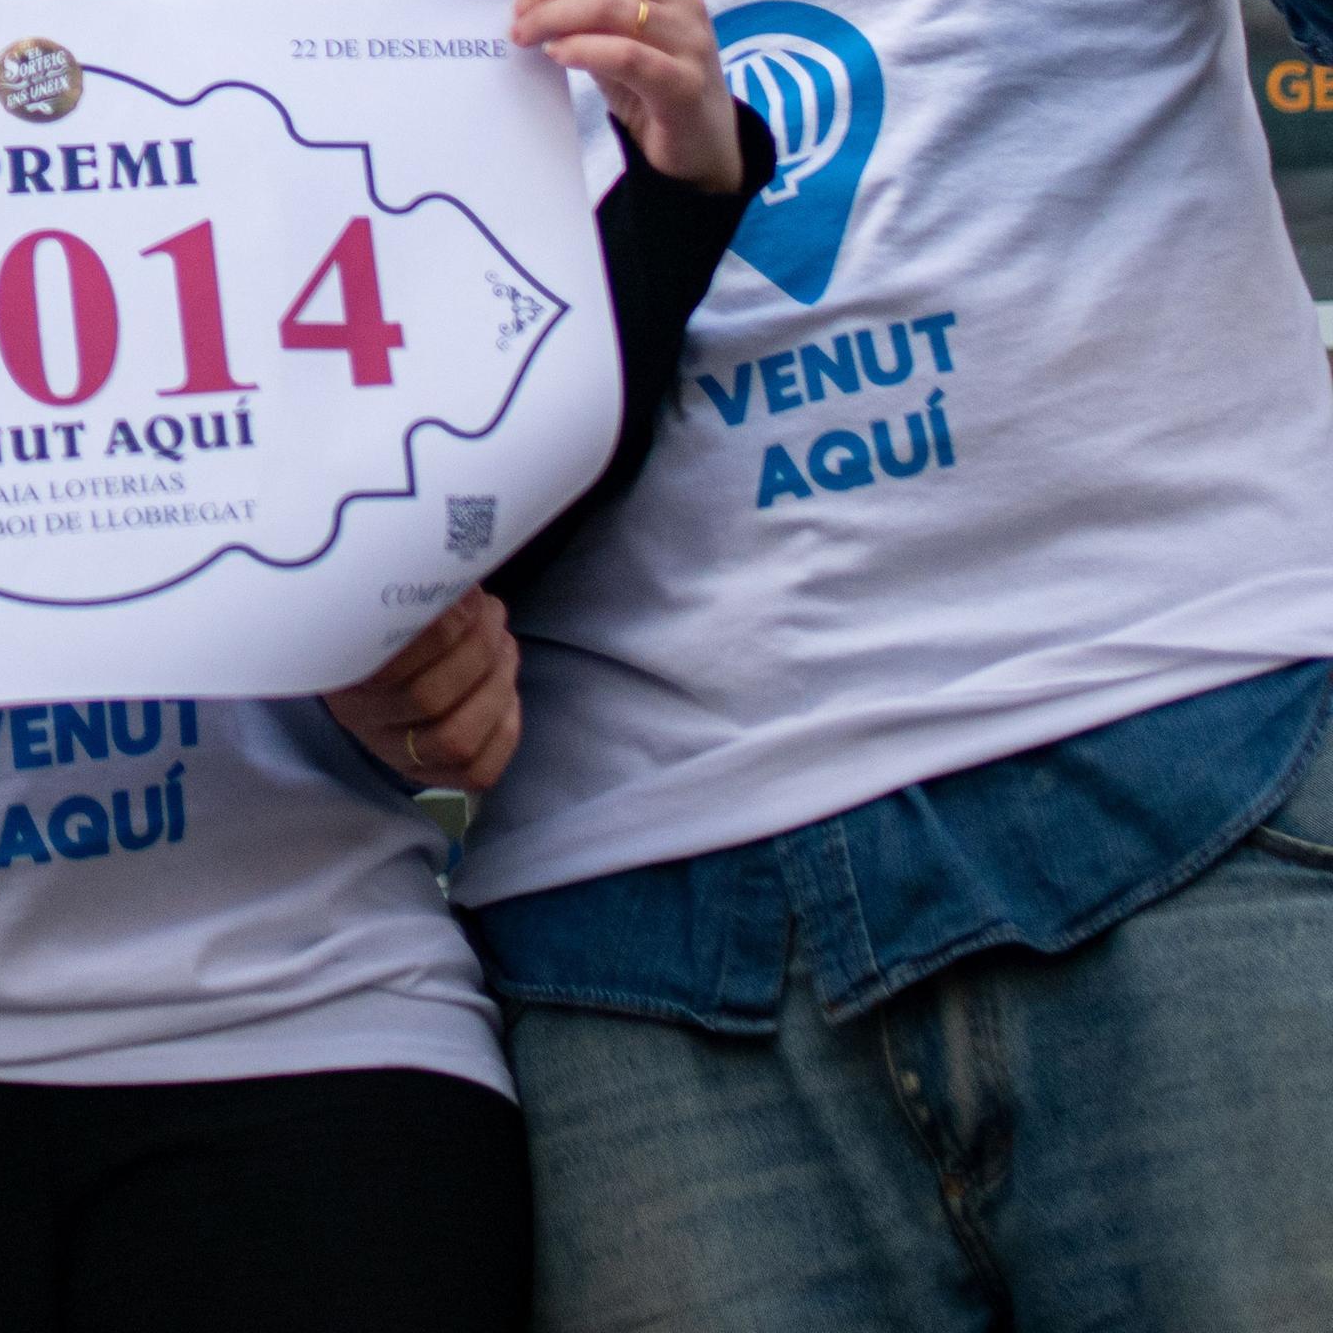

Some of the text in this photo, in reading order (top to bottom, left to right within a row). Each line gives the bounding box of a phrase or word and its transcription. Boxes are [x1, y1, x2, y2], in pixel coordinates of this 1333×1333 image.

[290, 38, 509, 59] 22 DE DESEMBRE
[695, 309, 957, 427] VENUT
[104, 396, 256, 463] AQUÍ
[756, 386, 956, 510] AQUÍ
[48, 471, 186, 502] LOTERIAS
[44, 510, 83, 536] DE
[90, 498, 258, 531] LLOBREGAT
